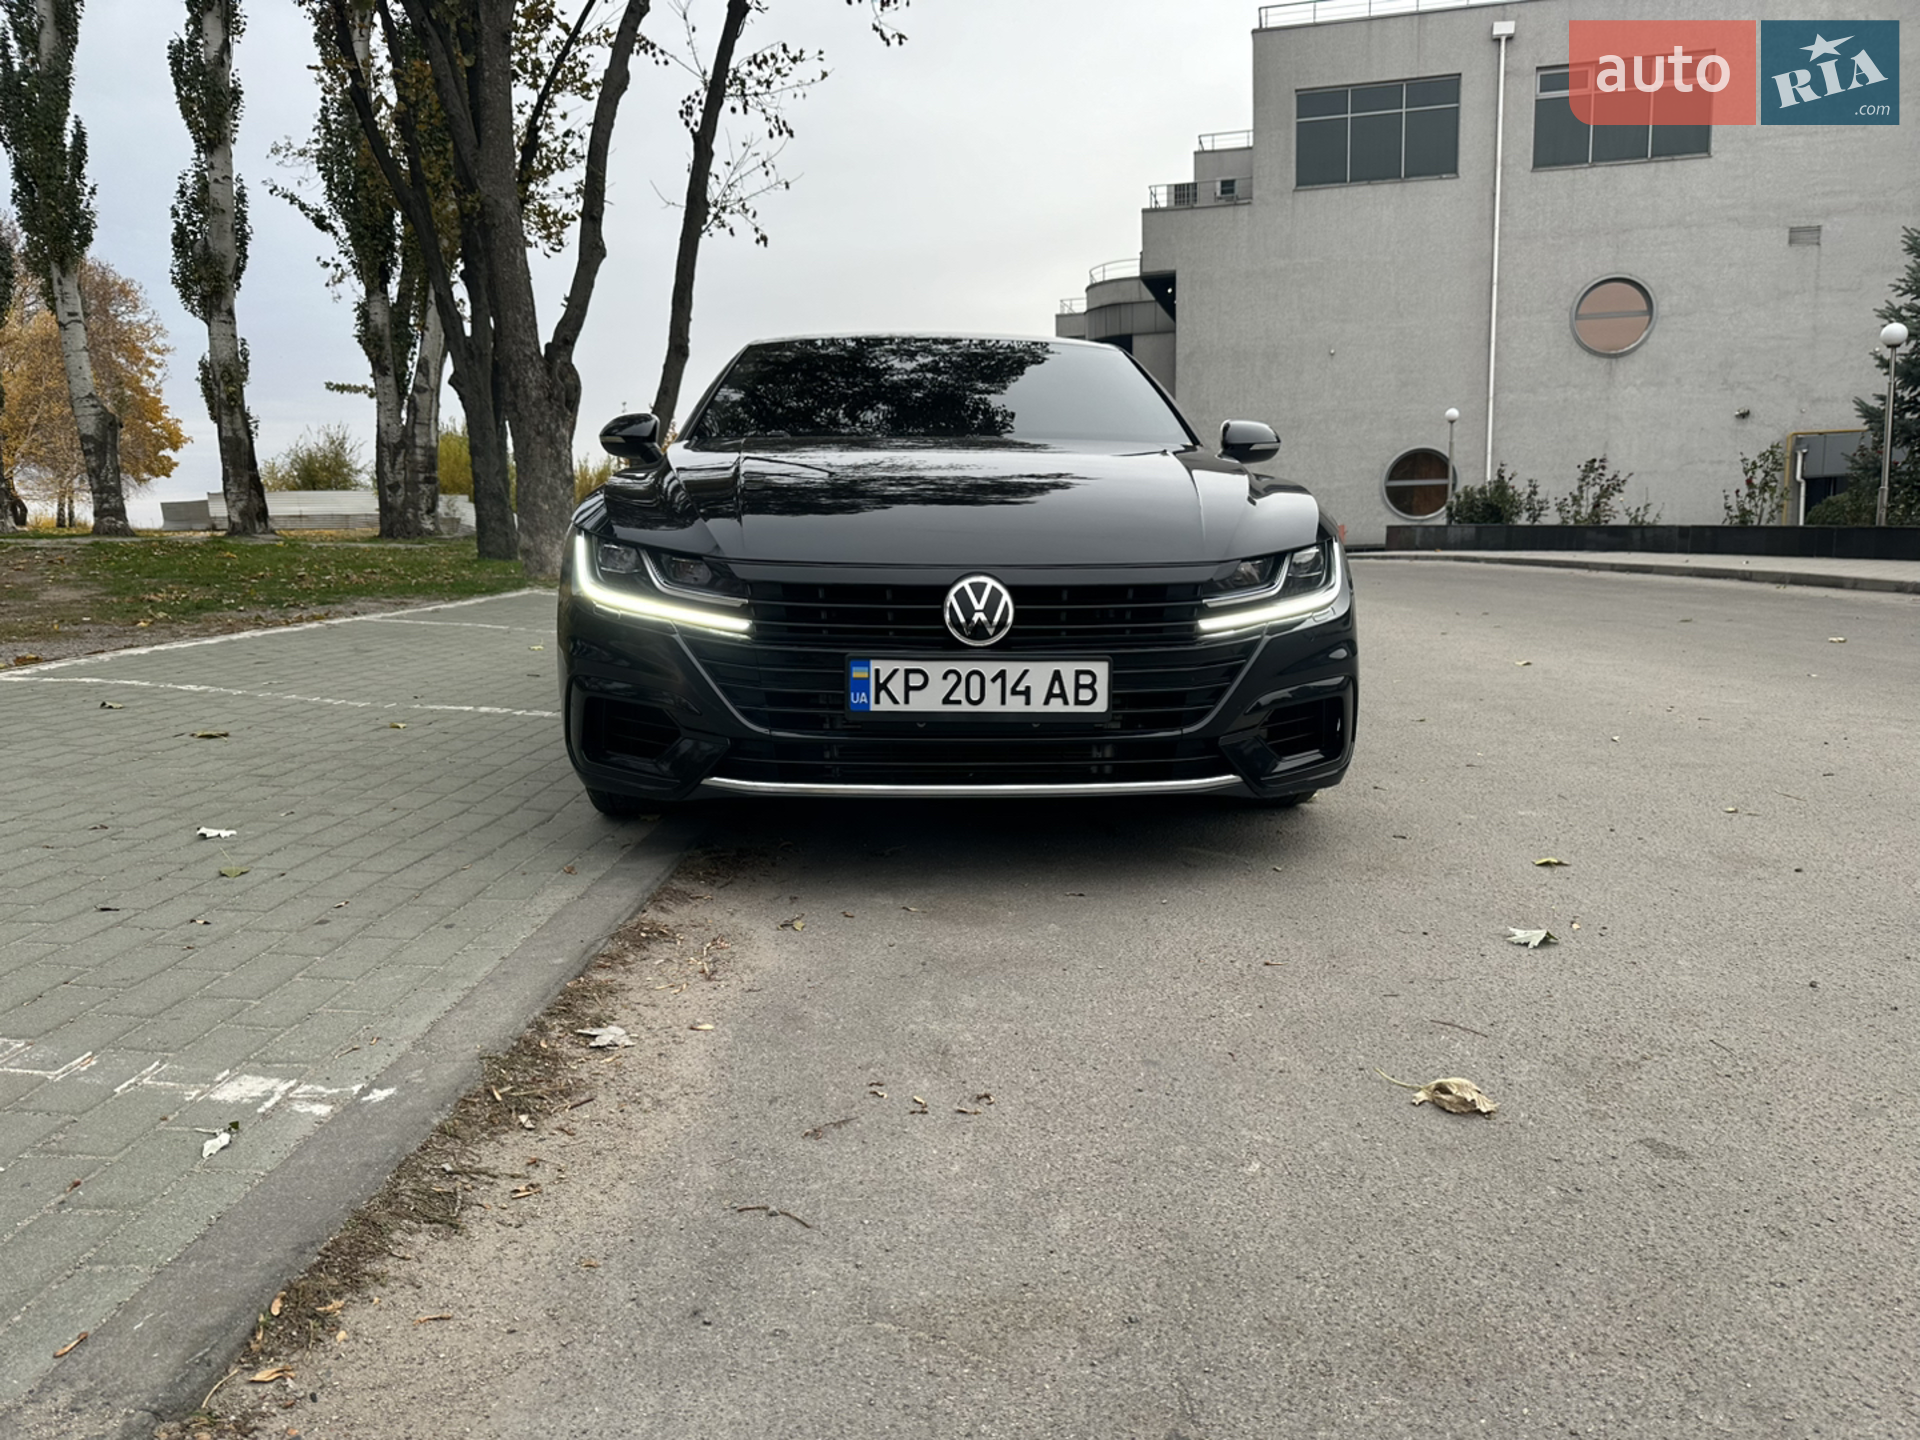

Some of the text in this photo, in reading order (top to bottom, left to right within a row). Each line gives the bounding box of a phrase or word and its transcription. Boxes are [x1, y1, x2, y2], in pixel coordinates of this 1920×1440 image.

[850, 692, 869, 704] UA
[873, 667, 1098, 706] KP 2014 AB
